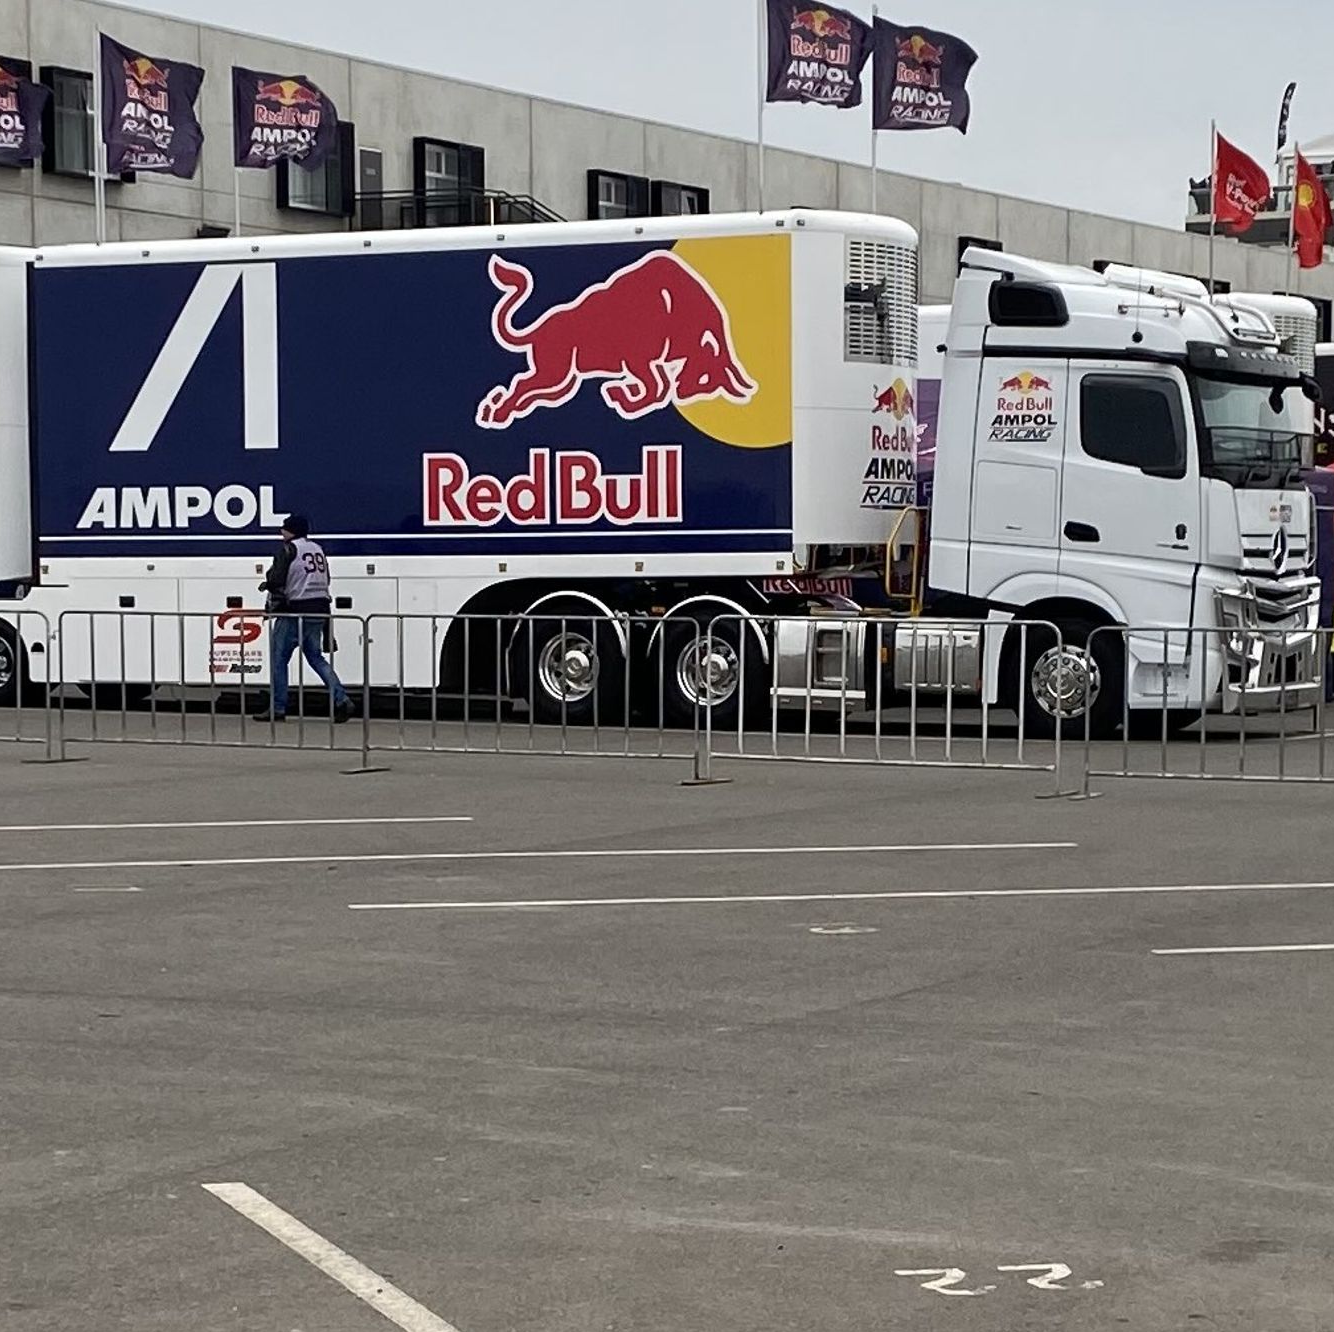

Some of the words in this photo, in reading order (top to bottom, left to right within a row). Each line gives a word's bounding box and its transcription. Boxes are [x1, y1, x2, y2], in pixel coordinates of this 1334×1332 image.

[997, 397, 1024, 411] Red
[1026, 397, 1052, 411] Bull
[991, 414, 1058, 426] AMPOL
[988, 428, 1054, 440] RACING
[423, 448, 551, 526] Red
[556, 445, 683, 526] Bull
[76, 484, 293, 529] AMPOL
[302, 552, 326, 574] 39
